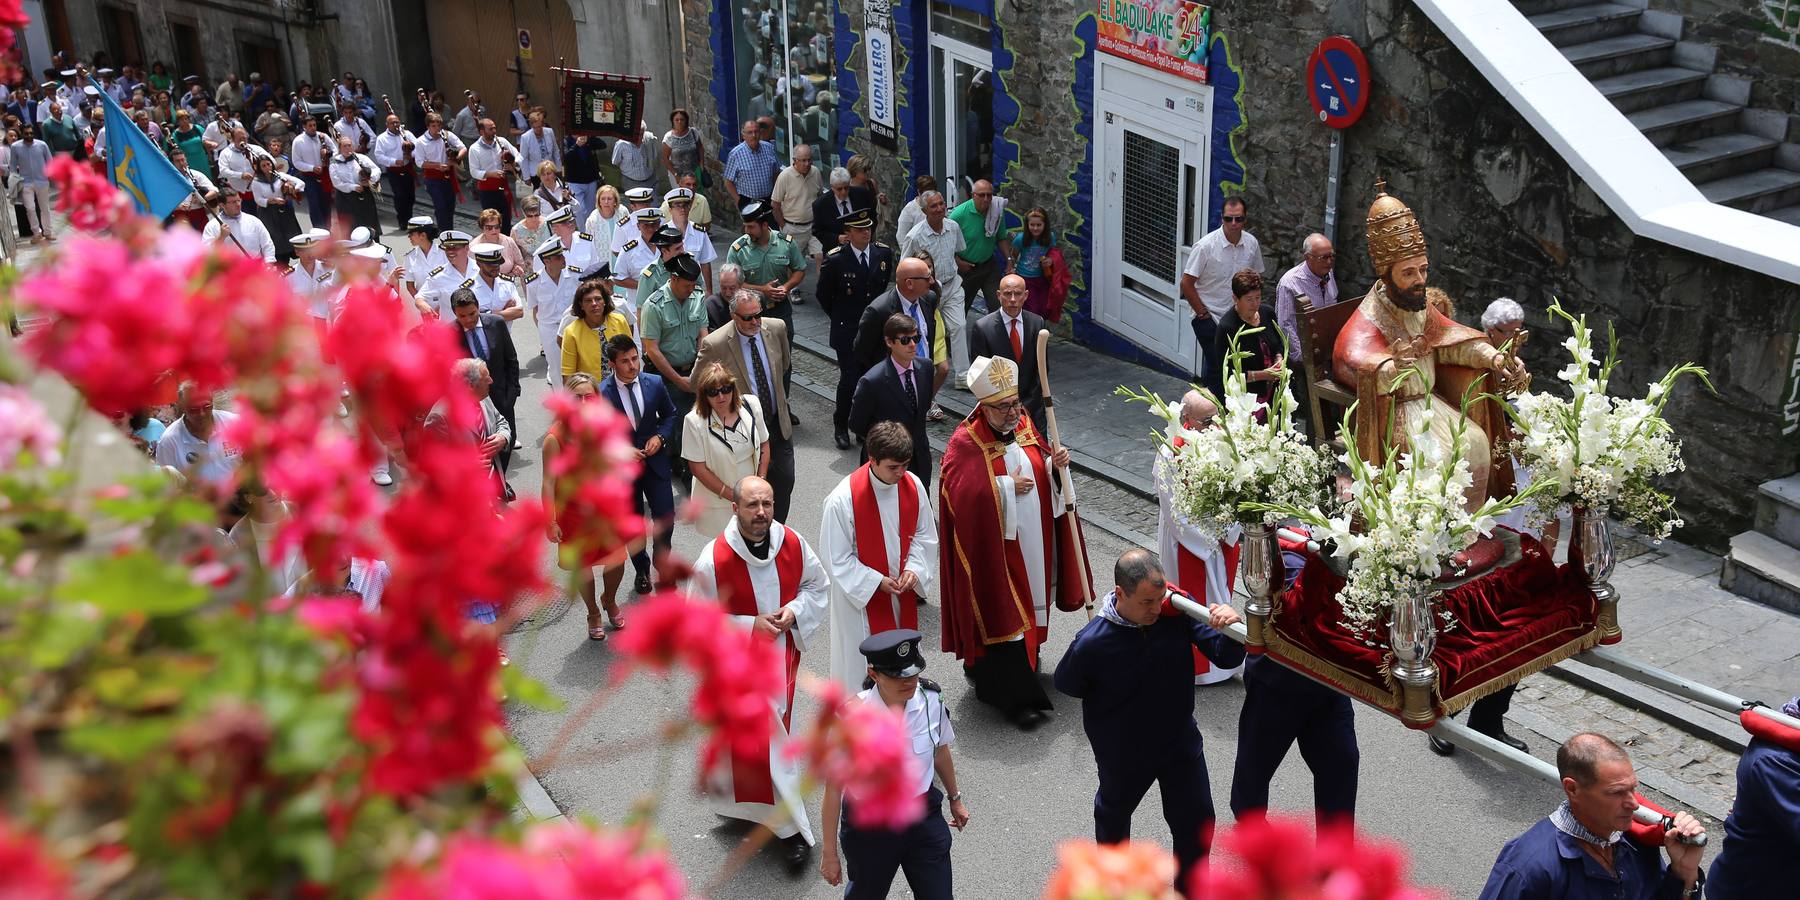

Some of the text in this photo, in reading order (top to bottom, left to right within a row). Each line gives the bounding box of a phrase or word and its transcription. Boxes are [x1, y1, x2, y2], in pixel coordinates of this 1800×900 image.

[1100, 0, 1113, 23] EL
[1115, 2, 1173, 40] BADULAKE
[871, 38, 885, 119] CUDILLERO
[624, 92, 633, 128] ASTURIAS
